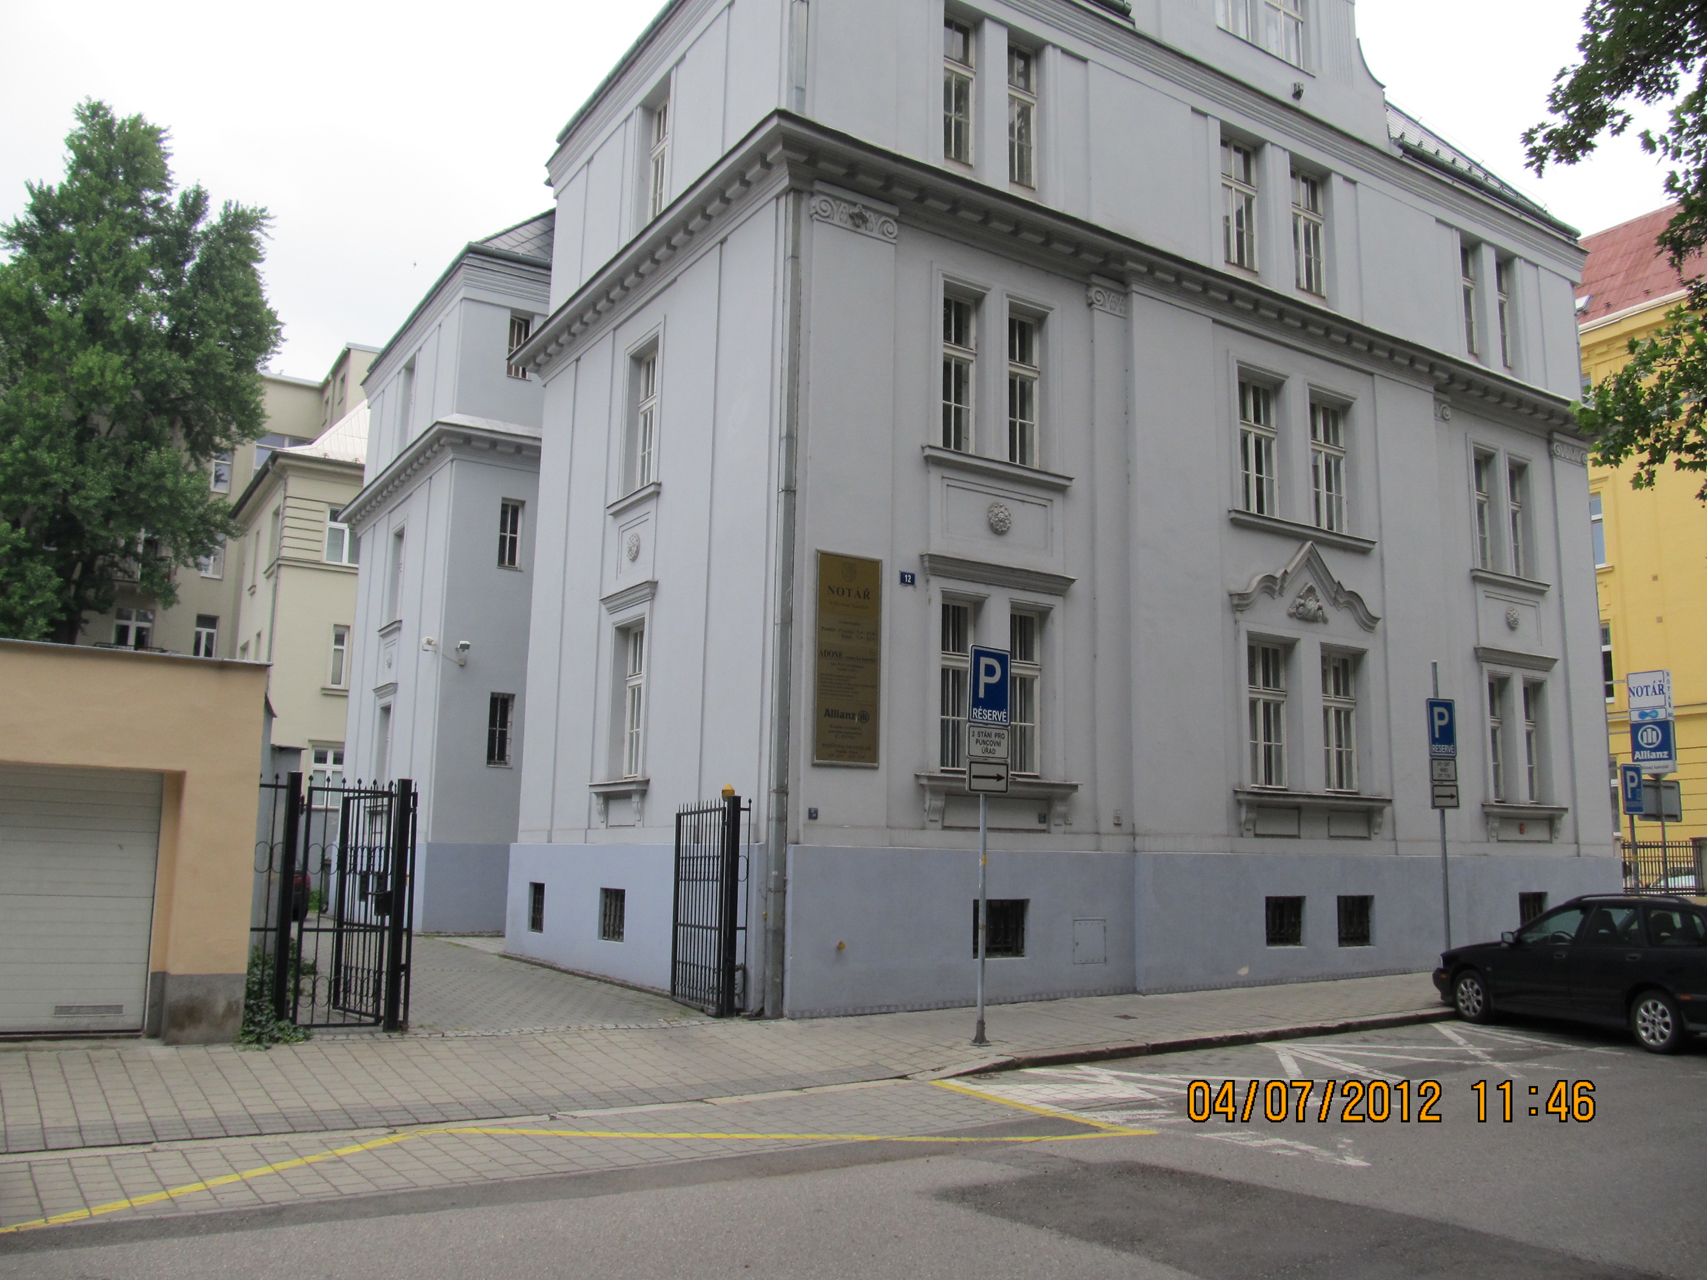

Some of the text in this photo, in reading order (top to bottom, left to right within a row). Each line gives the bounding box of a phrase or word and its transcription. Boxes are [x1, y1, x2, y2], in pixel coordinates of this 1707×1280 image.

[904, 574, 912, 583] 12
[827, 585, 871, 600] NOTÁŘ
[978, 656, 1002, 698] P
[1628, 680, 1666, 697] NOTÁŘ
[824, 708, 856, 720] Allianz
[972, 705, 1007, 722] RÉSERVÉ
[1433, 706, 1450, 738] P
[994, 732, 1005, 740] PRO
[1634, 750, 1669, 760] Allianz
[1626, 771, 1638, 799] P
